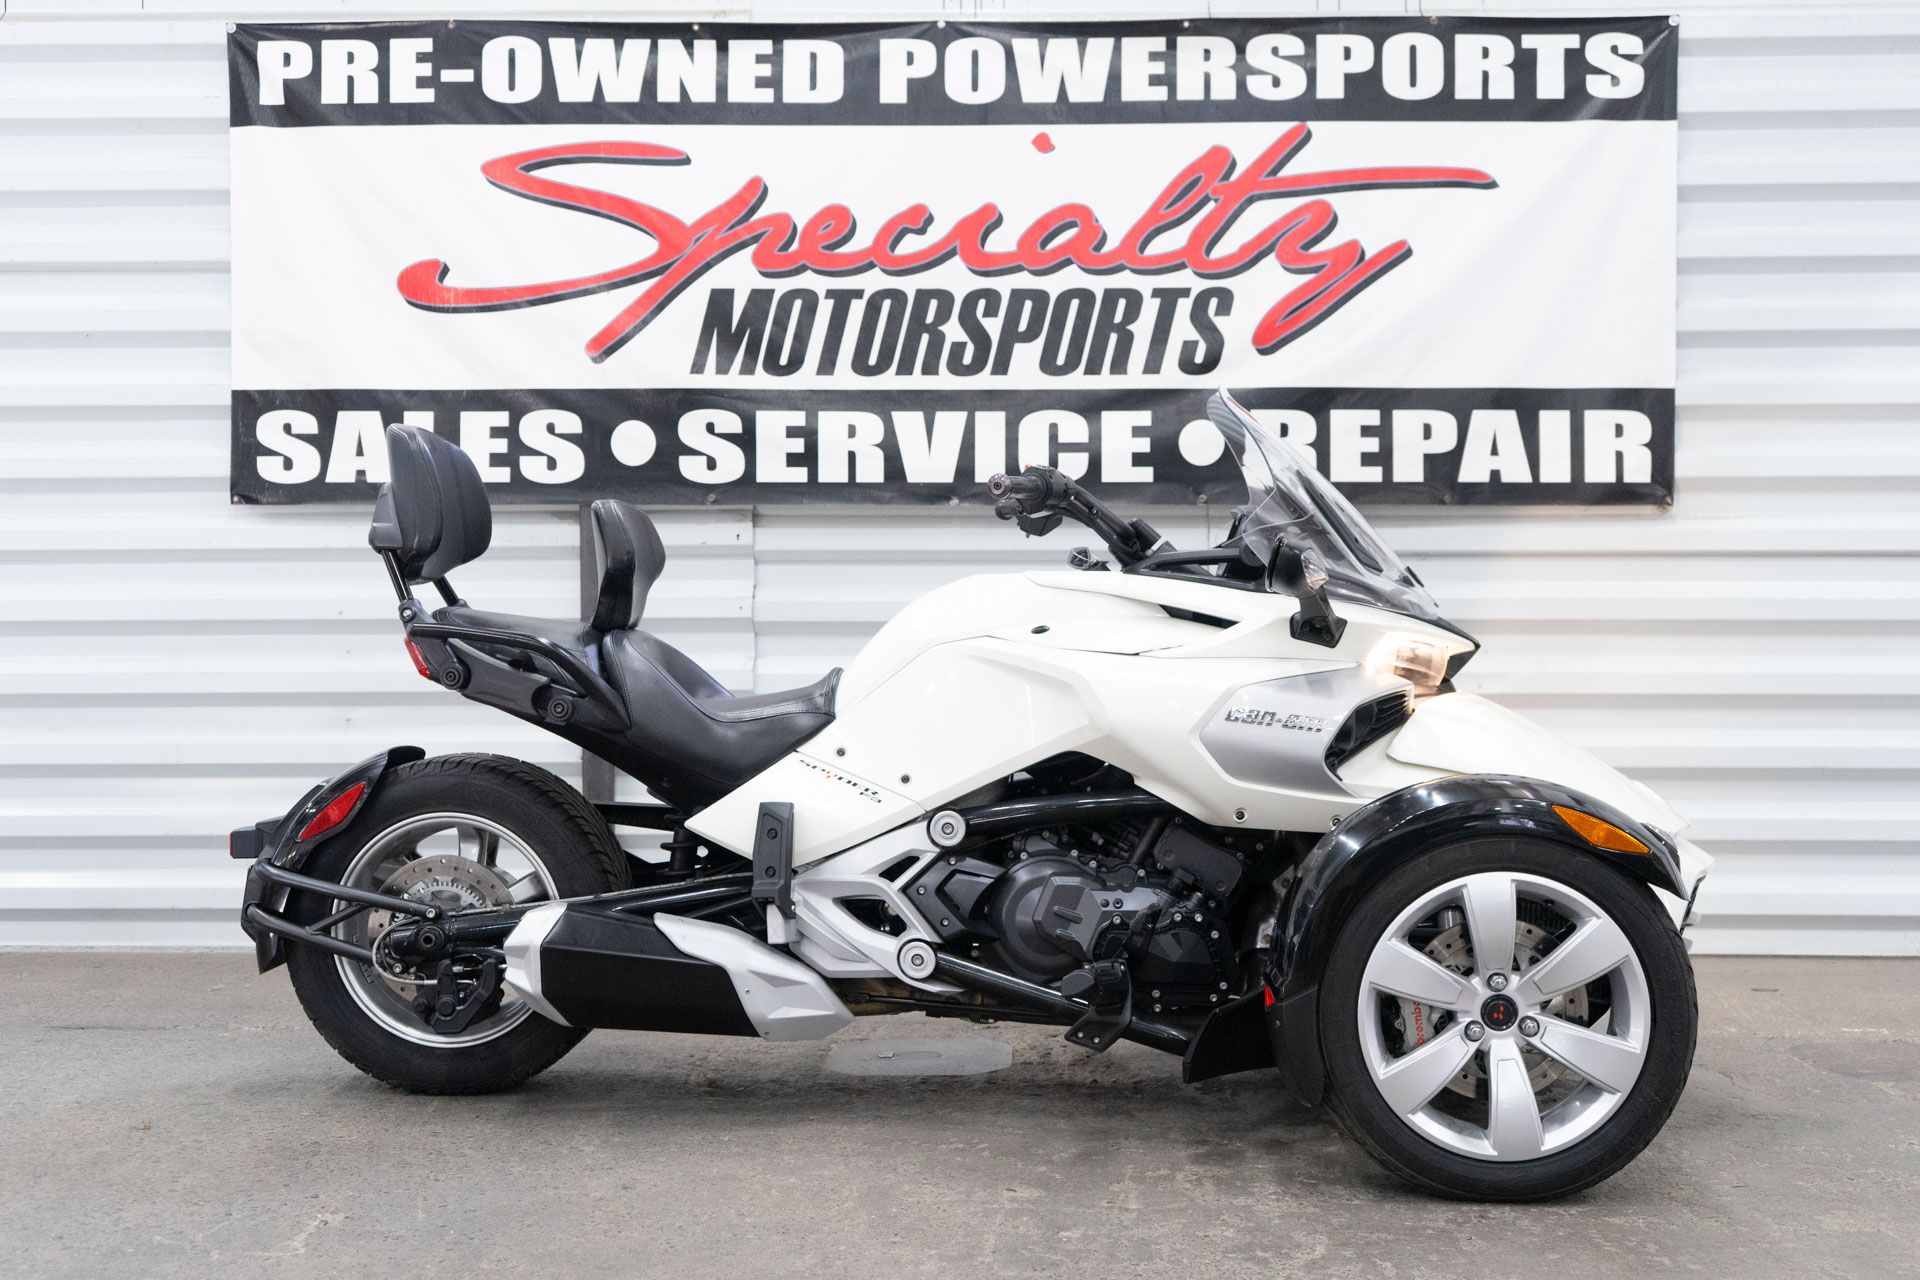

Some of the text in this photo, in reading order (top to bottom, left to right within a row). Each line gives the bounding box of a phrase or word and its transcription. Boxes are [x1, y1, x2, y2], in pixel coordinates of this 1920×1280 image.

[256, 31, 1646, 107] PRE-OWNED POWERSPORTS
[396, 121, 1499, 363] Specialty
[690, 285, 1235, 377] MOTORSPORTS
[678, 409, 1154, 485] SERVICE
